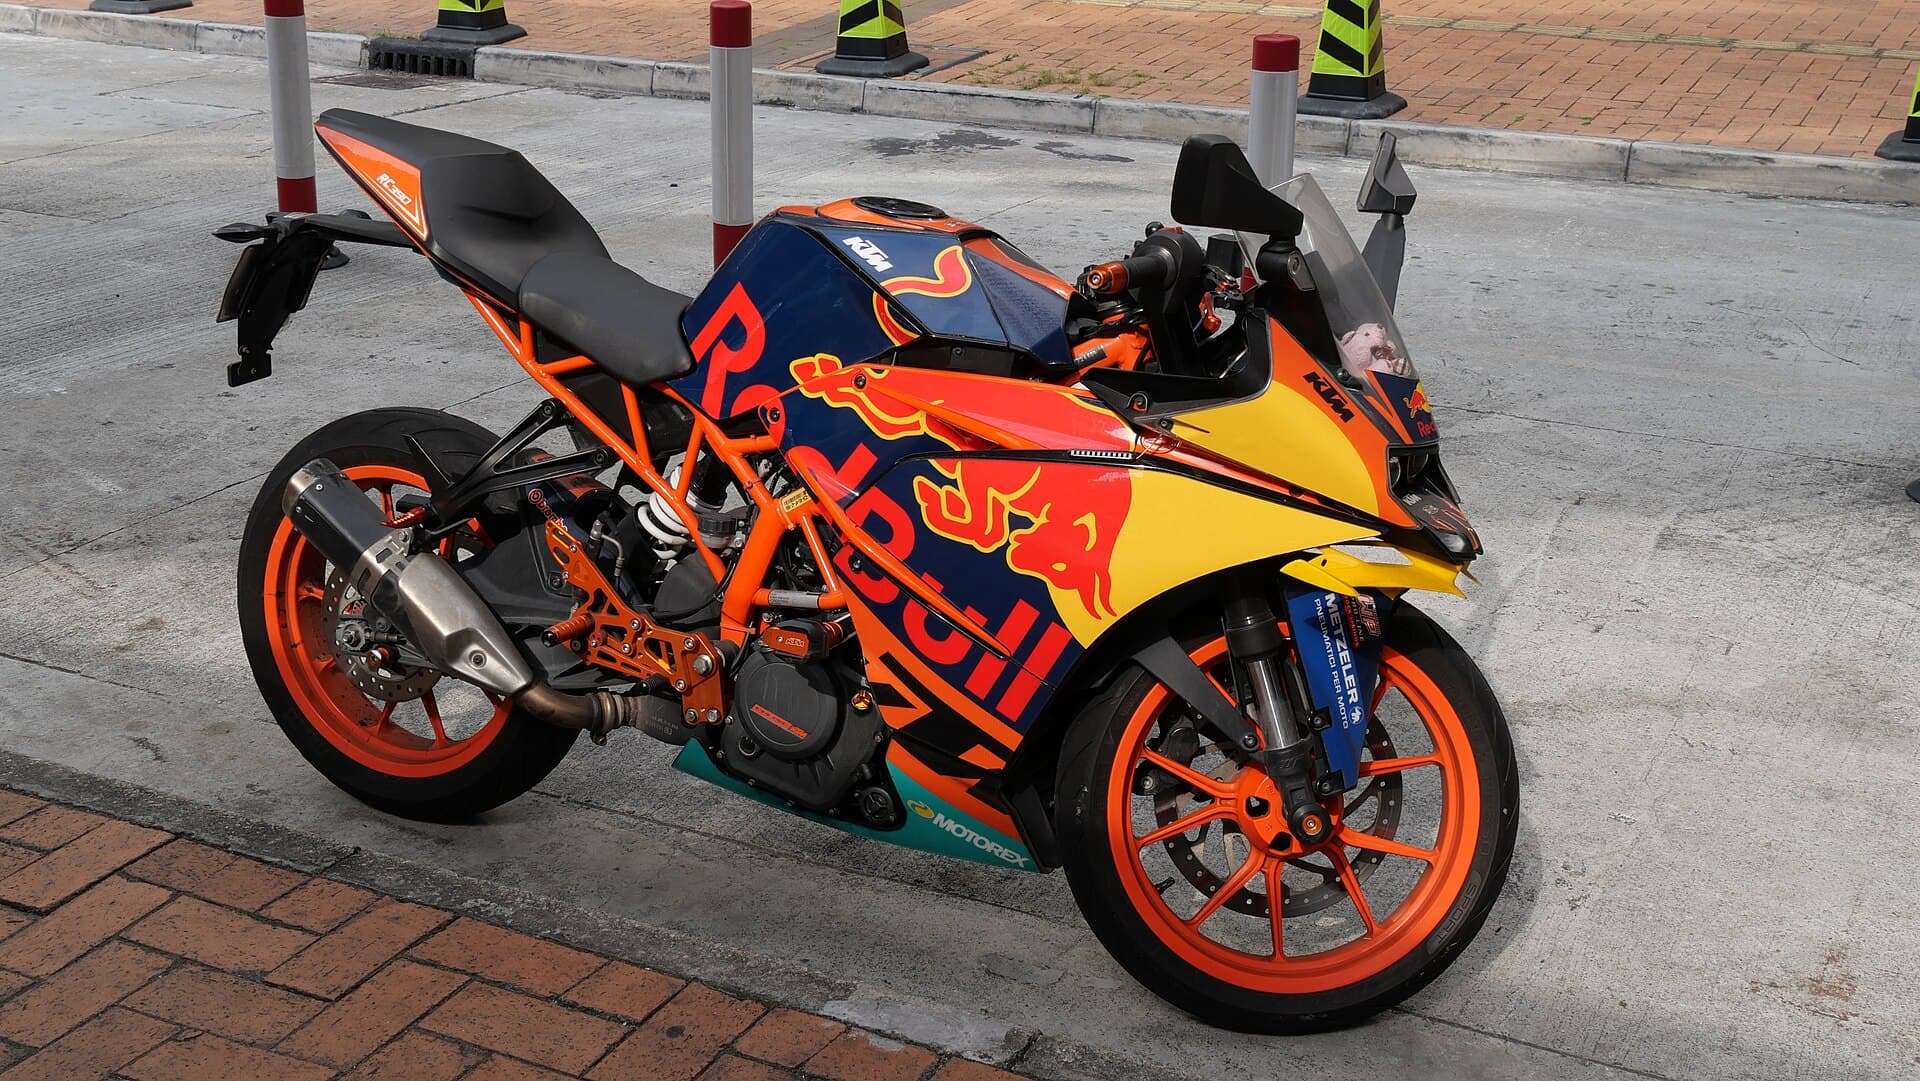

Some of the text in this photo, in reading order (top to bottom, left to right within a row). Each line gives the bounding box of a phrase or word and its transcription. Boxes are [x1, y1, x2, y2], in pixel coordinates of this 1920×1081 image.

[842, 236, 894, 273] KTM
[1302, 371, 1355, 423] KTM
[692, 281, 879, 546] Red
[832, 484, 1074, 723] Bull
[1314, 598, 1349, 729] PNEUMATICI PER MOTO
[1325, 592, 1360, 705] METZELER
[932, 812, 1030, 868] MOTOREX
[1437, 885, 1477, 944] SPORT
